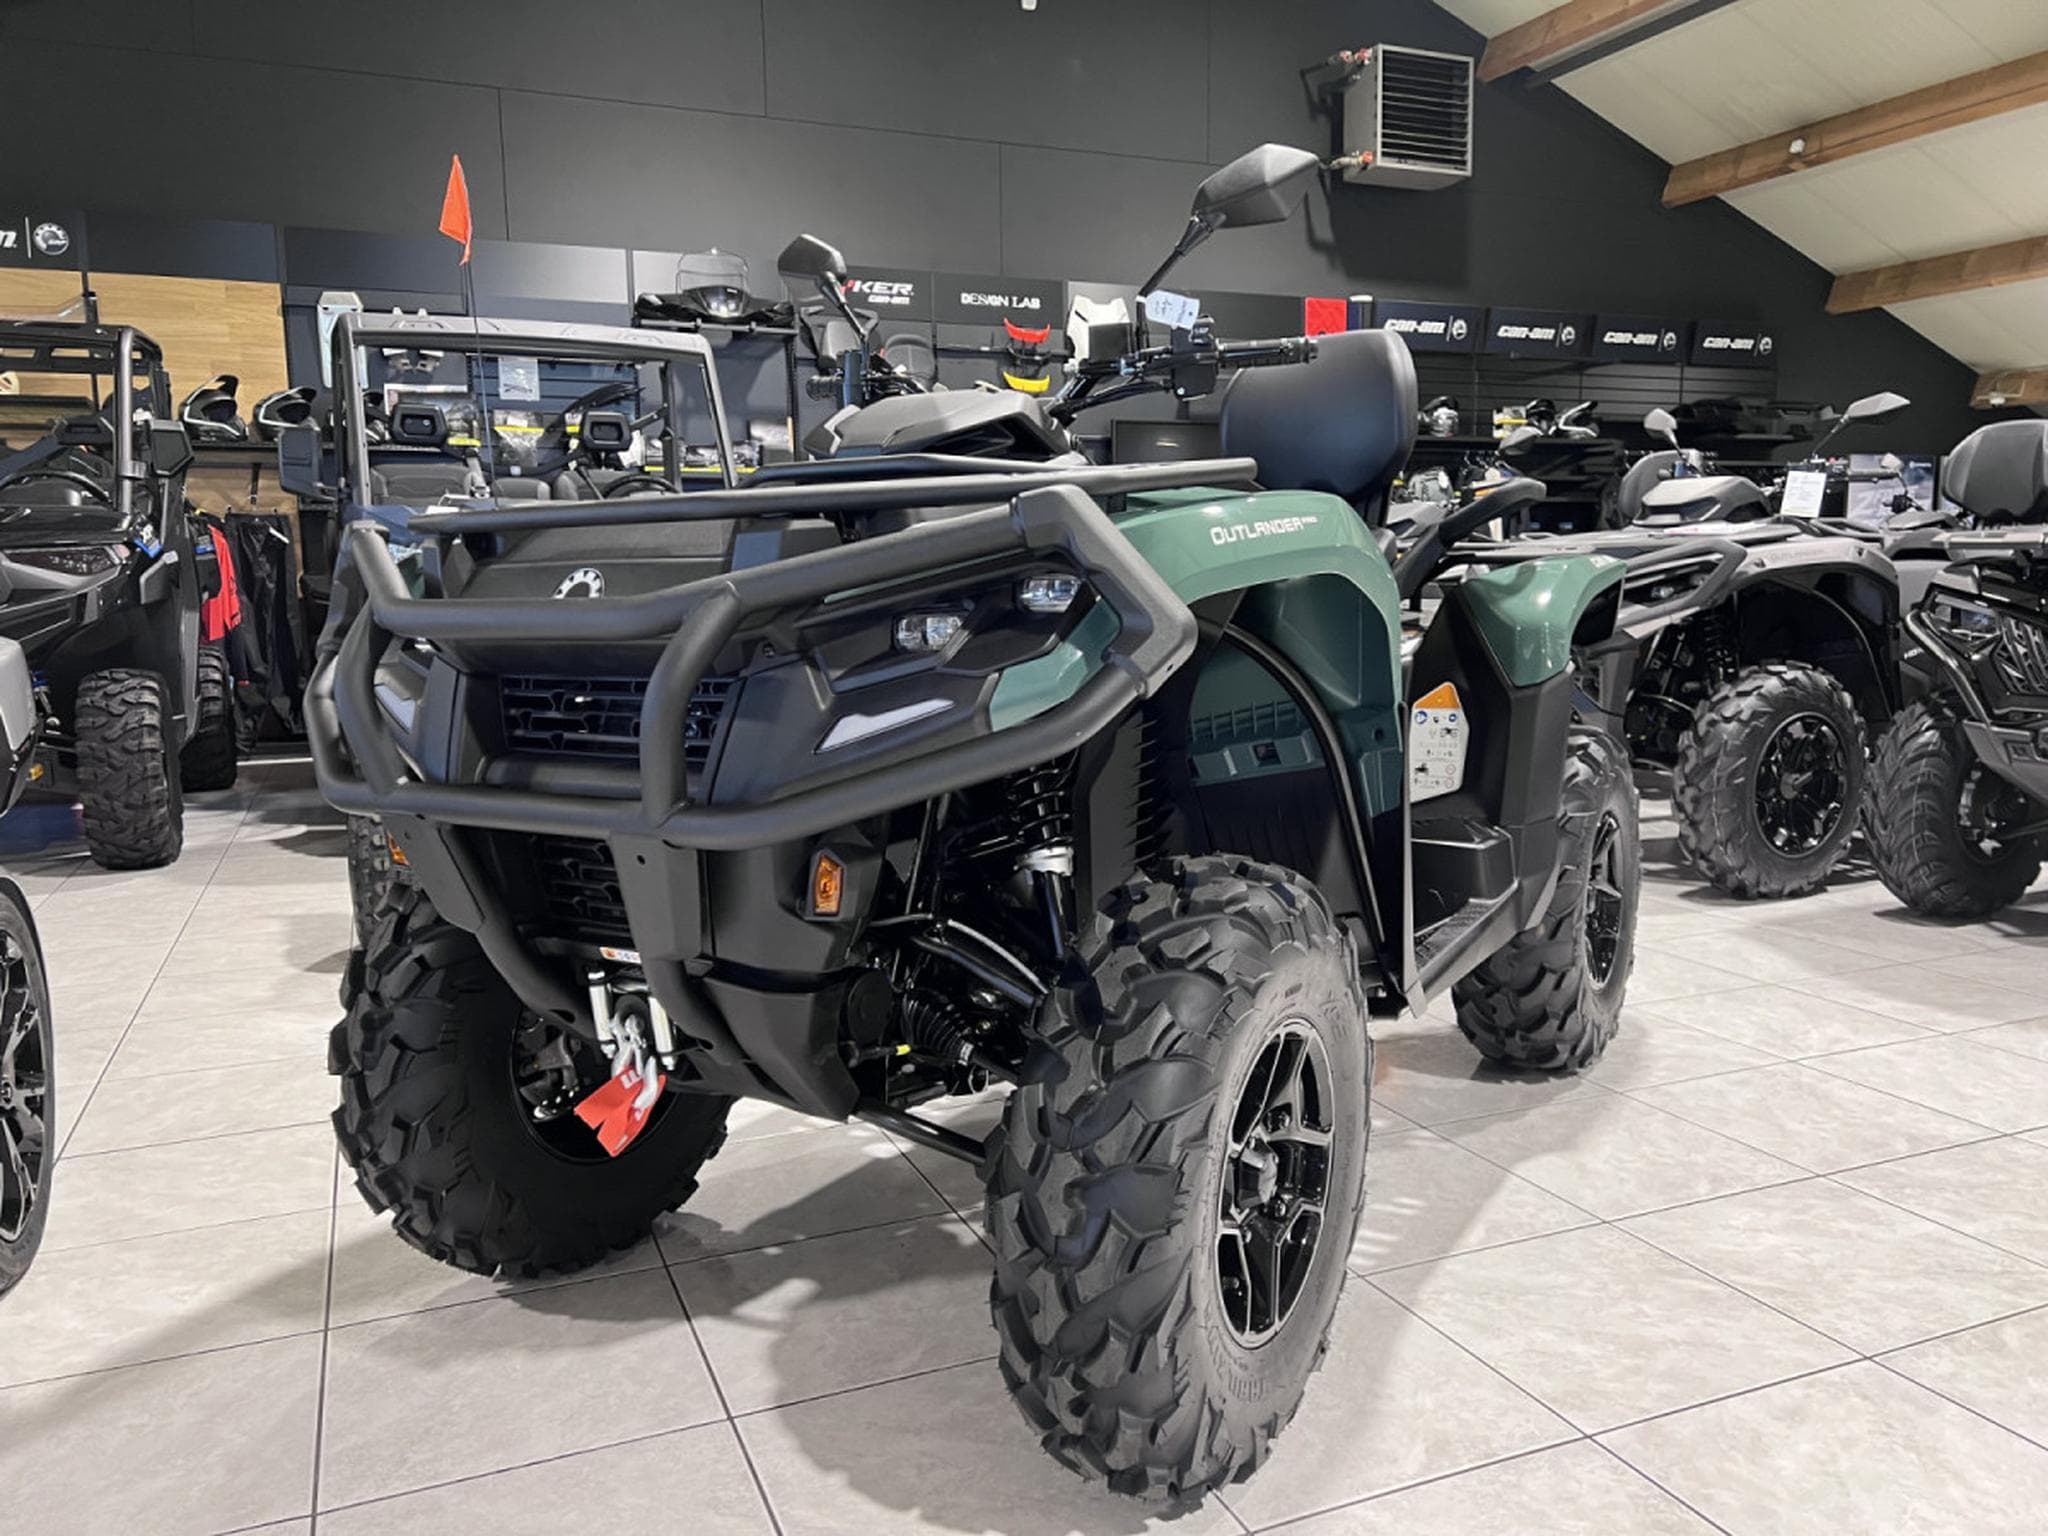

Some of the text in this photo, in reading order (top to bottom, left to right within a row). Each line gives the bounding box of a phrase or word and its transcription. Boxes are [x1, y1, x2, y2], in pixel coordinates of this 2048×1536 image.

[840, 279, 915, 296] KER
[960, 292, 1041, 309] DESIGN LAB
[1210, 516, 1304, 545] OUTLANDER
